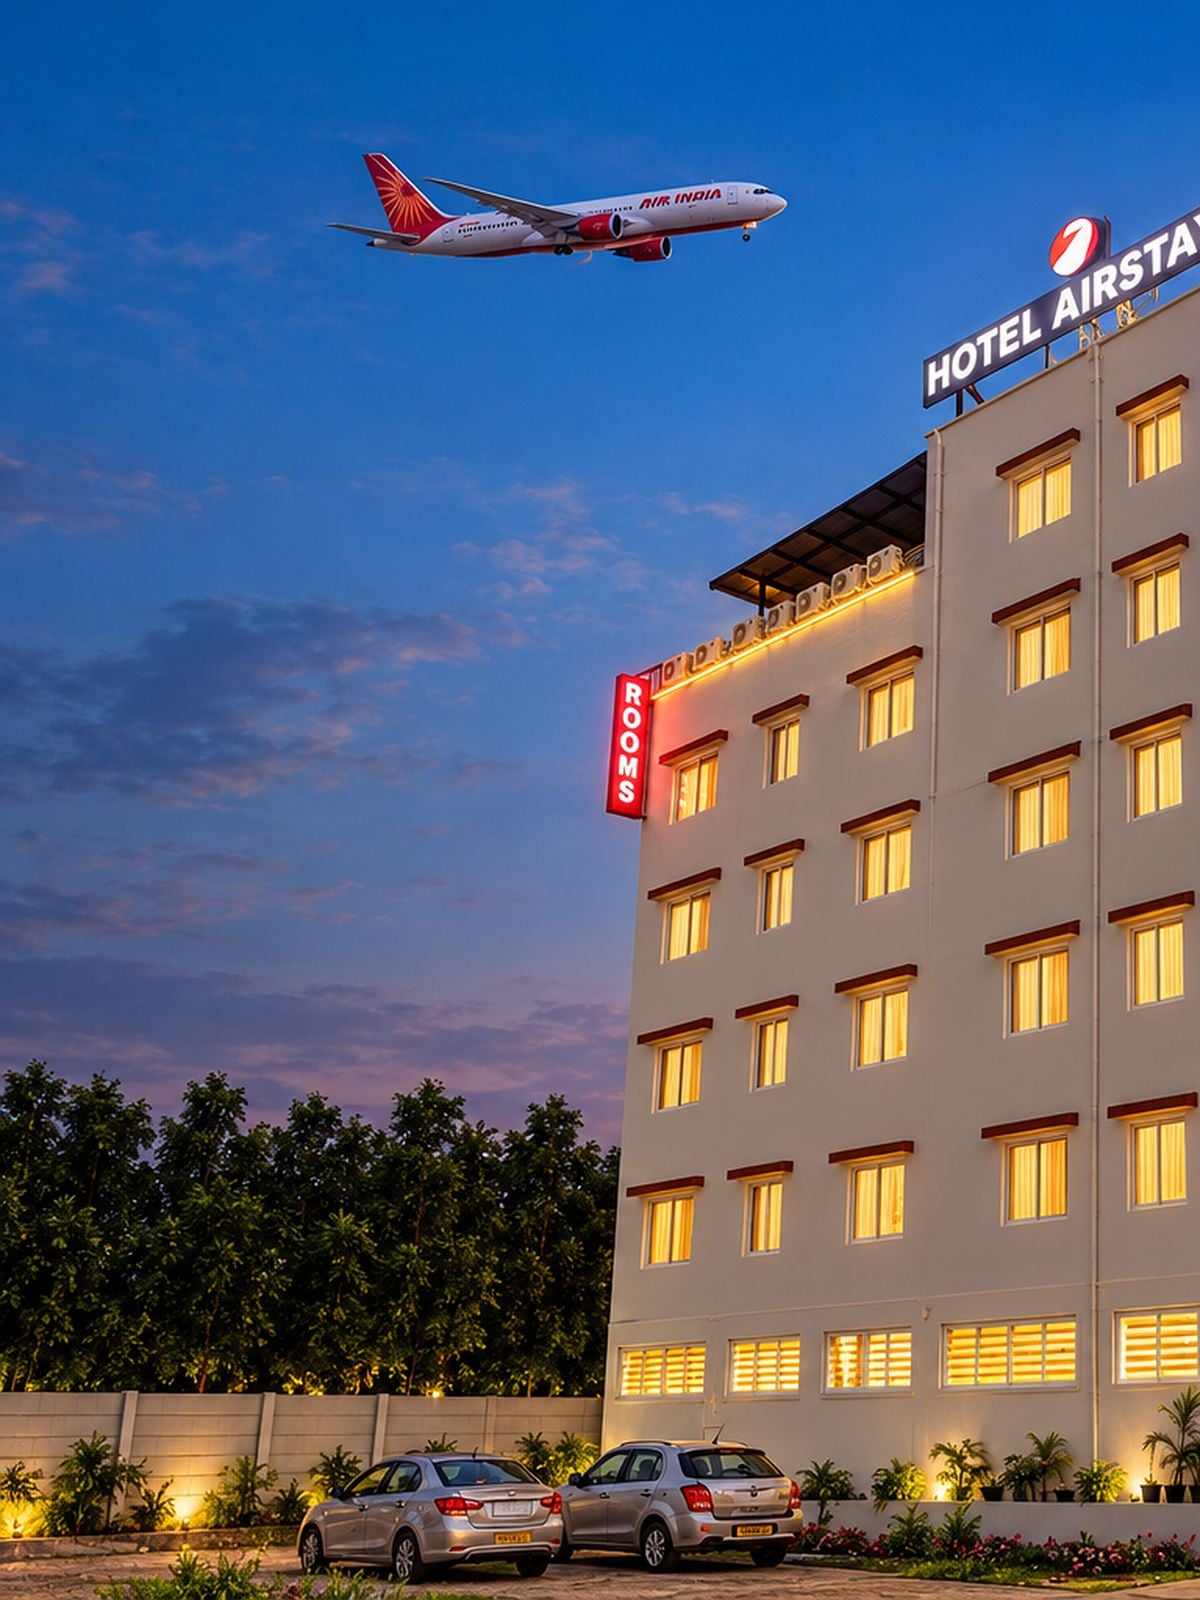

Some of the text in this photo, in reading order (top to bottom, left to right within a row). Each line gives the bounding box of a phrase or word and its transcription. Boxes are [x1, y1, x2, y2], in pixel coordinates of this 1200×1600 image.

[639, 188, 722, 210] AIR INDIA
[928, 309, 1041, 396] HOTEL
[618, 682, 642, 803] ROOMS
